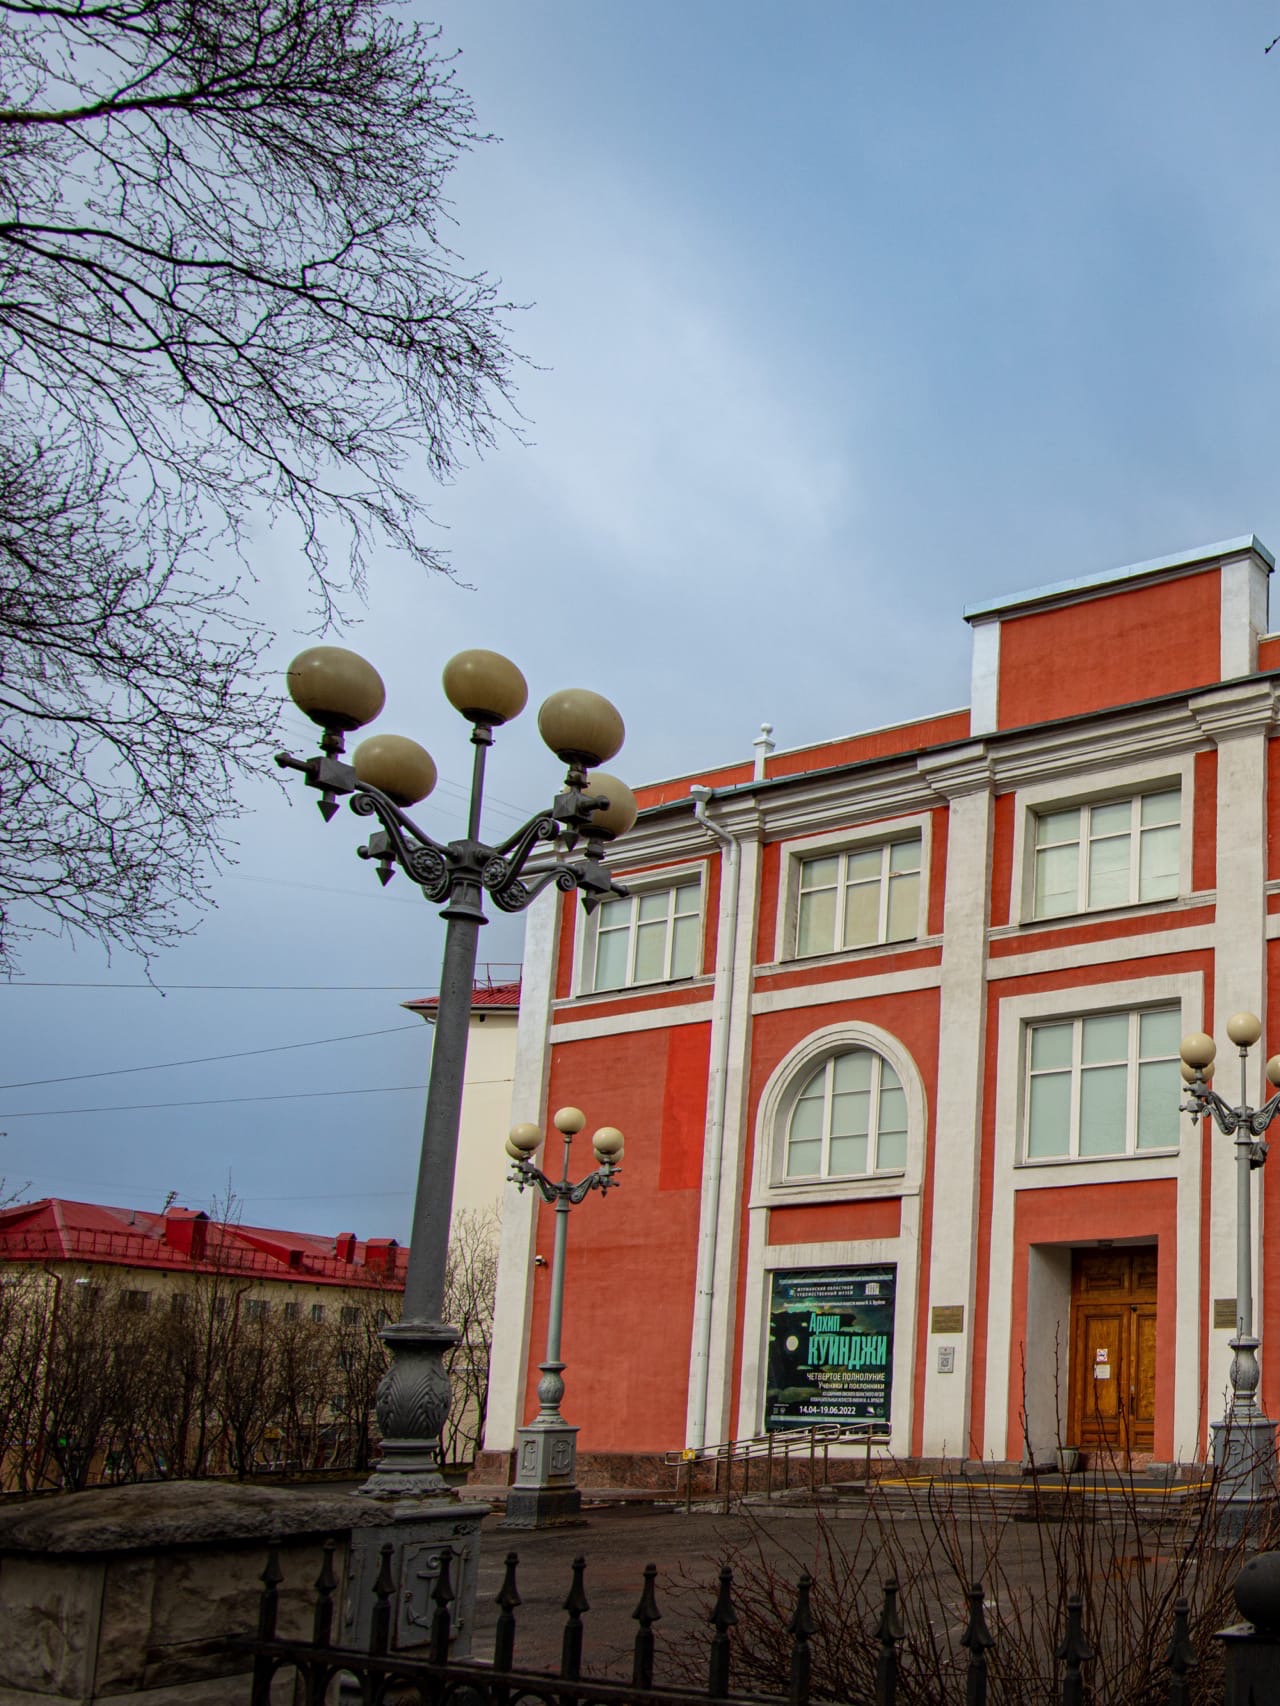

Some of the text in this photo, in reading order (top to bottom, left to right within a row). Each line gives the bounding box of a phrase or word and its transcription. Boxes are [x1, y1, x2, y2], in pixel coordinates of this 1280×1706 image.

[808, 1312, 841, 1336] Архип
[807, 1335, 888, 1370] КУИНДЖИ
[807, 1372, 886, 1381] ЧЕТВЕРТОЕ ПОЛНОЛУНИЕ
